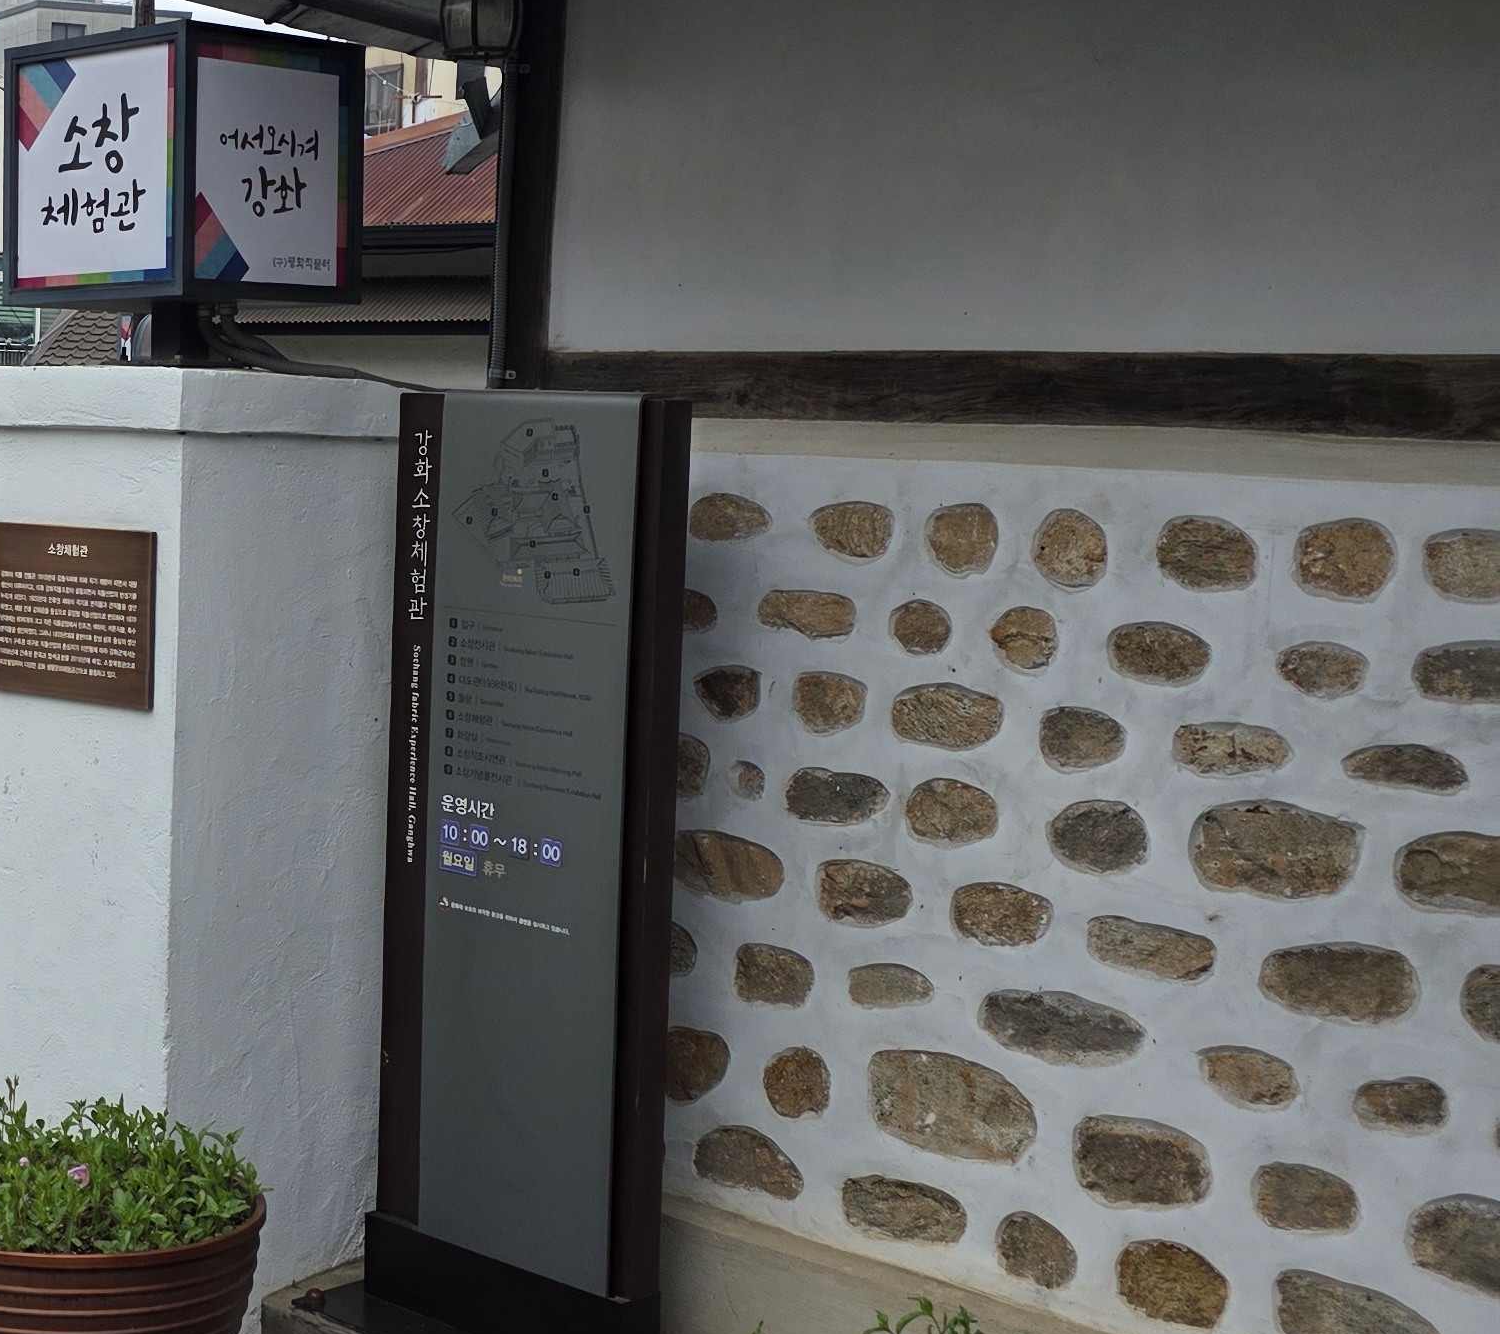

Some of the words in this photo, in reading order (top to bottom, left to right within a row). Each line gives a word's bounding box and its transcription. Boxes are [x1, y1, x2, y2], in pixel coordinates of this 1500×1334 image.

[58, 93, 140, 174] 소창
[219, 124, 320, 161] 어서오시겨
[41, 179, 146, 233] 체험관
[241, 166, 308, 218] 강화
[47, 543, 89, 558] 소창체험관
[410, 644, 421, 688] Sochang
[411, 692, 420, 723] fabric
[408, 726, 419, 784] Experience
[441, 794, 495, 820] 운영시간
[405, 814, 416, 863] Ganghwa
[442, 850, 475, 872] 월요일
[482, 860, 506, 878] 휴무
